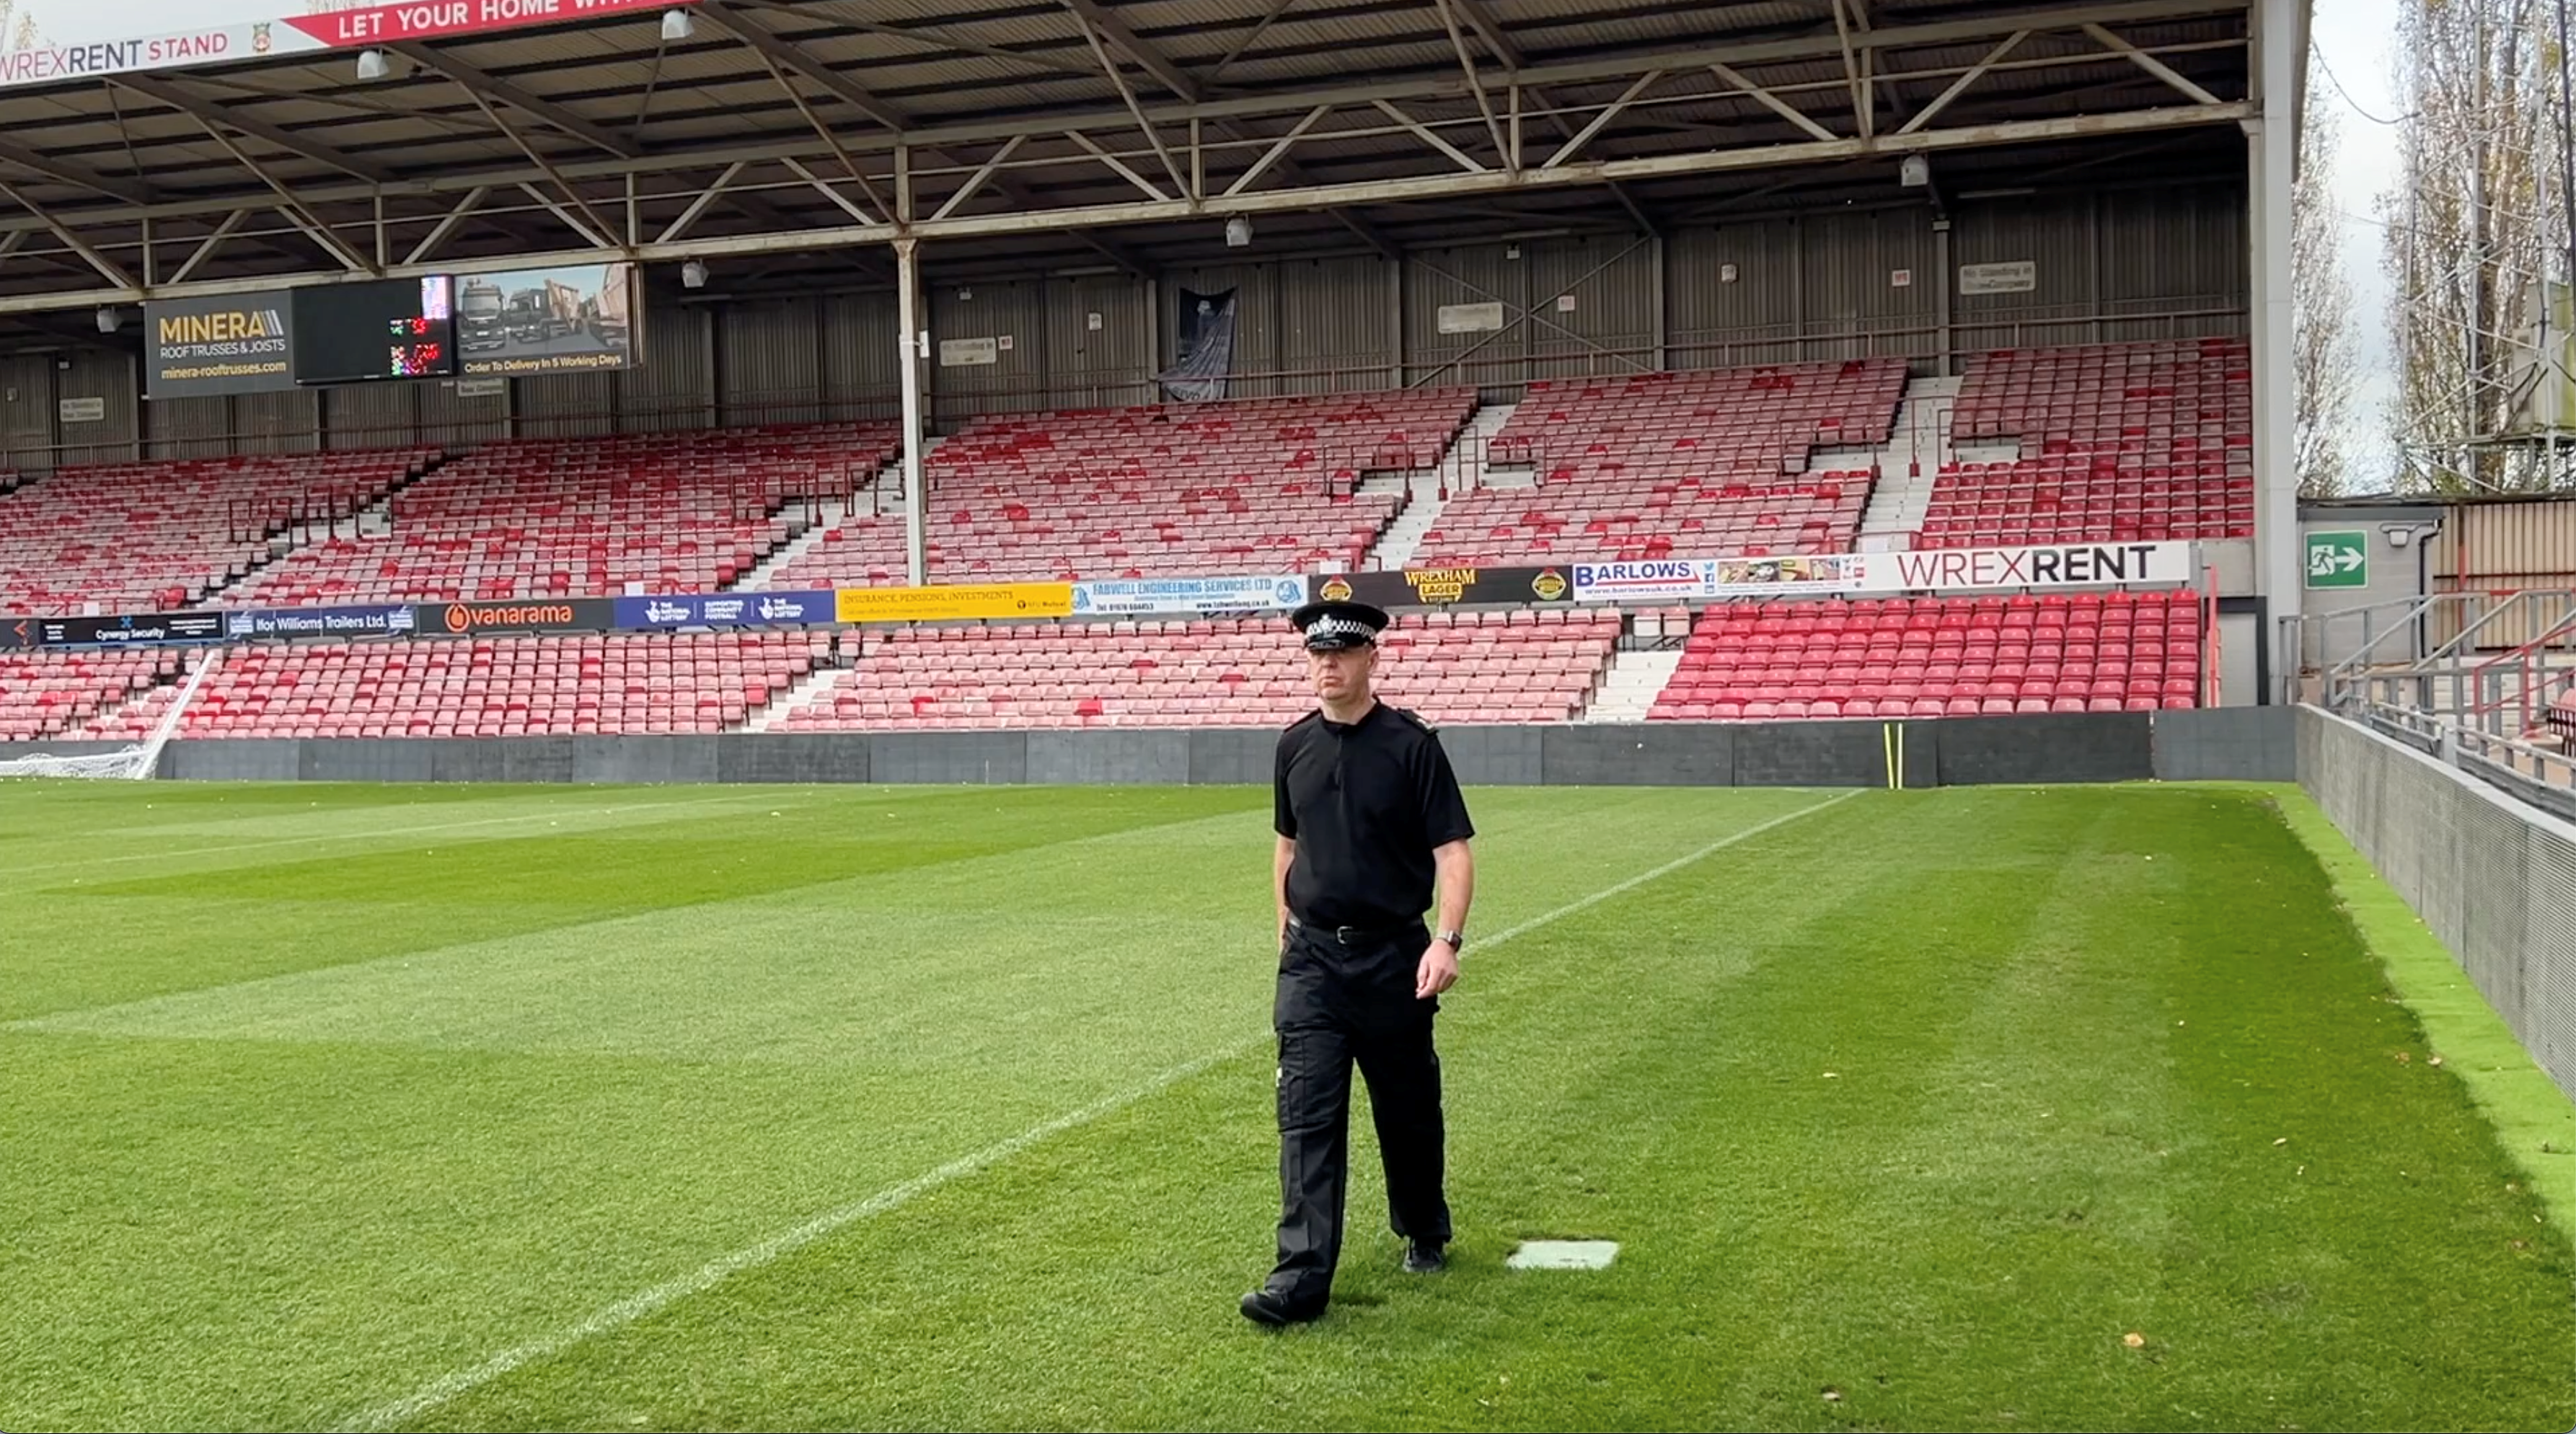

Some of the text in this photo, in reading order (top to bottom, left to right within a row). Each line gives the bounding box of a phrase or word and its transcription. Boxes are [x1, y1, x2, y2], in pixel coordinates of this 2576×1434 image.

[339, 0, 559, 39] LET YOUR HOME
[0, 32, 228, 81] WREXRENT STAND
[159, 311, 265, 344] MINERA
[160, 339, 286, 359] ROOF TRUSSES & JOISTS
[161, 361, 286, 379] minera-rooftrusses.com
[464, 354, 622, 373] Order To Delivery In 5 Working Days
[1576, 562, 1690, 586] BARLOWS
[1896, 545, 2156, 586] WREXRENT
[1138, 580, 1202, 594] ENGINEERING
[1204, 579, 1251, 591] SERVICES
[1255, 579, 1272, 590] LTD
[1404, 569, 1476, 586] WREXHAM
[1422, 584, 1460, 594] LAGER
[256, 618, 275, 631] Ifor
[276, 617, 323, 630] Williams
[325, 615, 363, 629] Trailers
[366, 615, 387, 628] Ltd.
[471, 605, 573, 625] vanarama
[95, 630, 130, 641] Cynergy
[131, 627, 165, 639] Security
